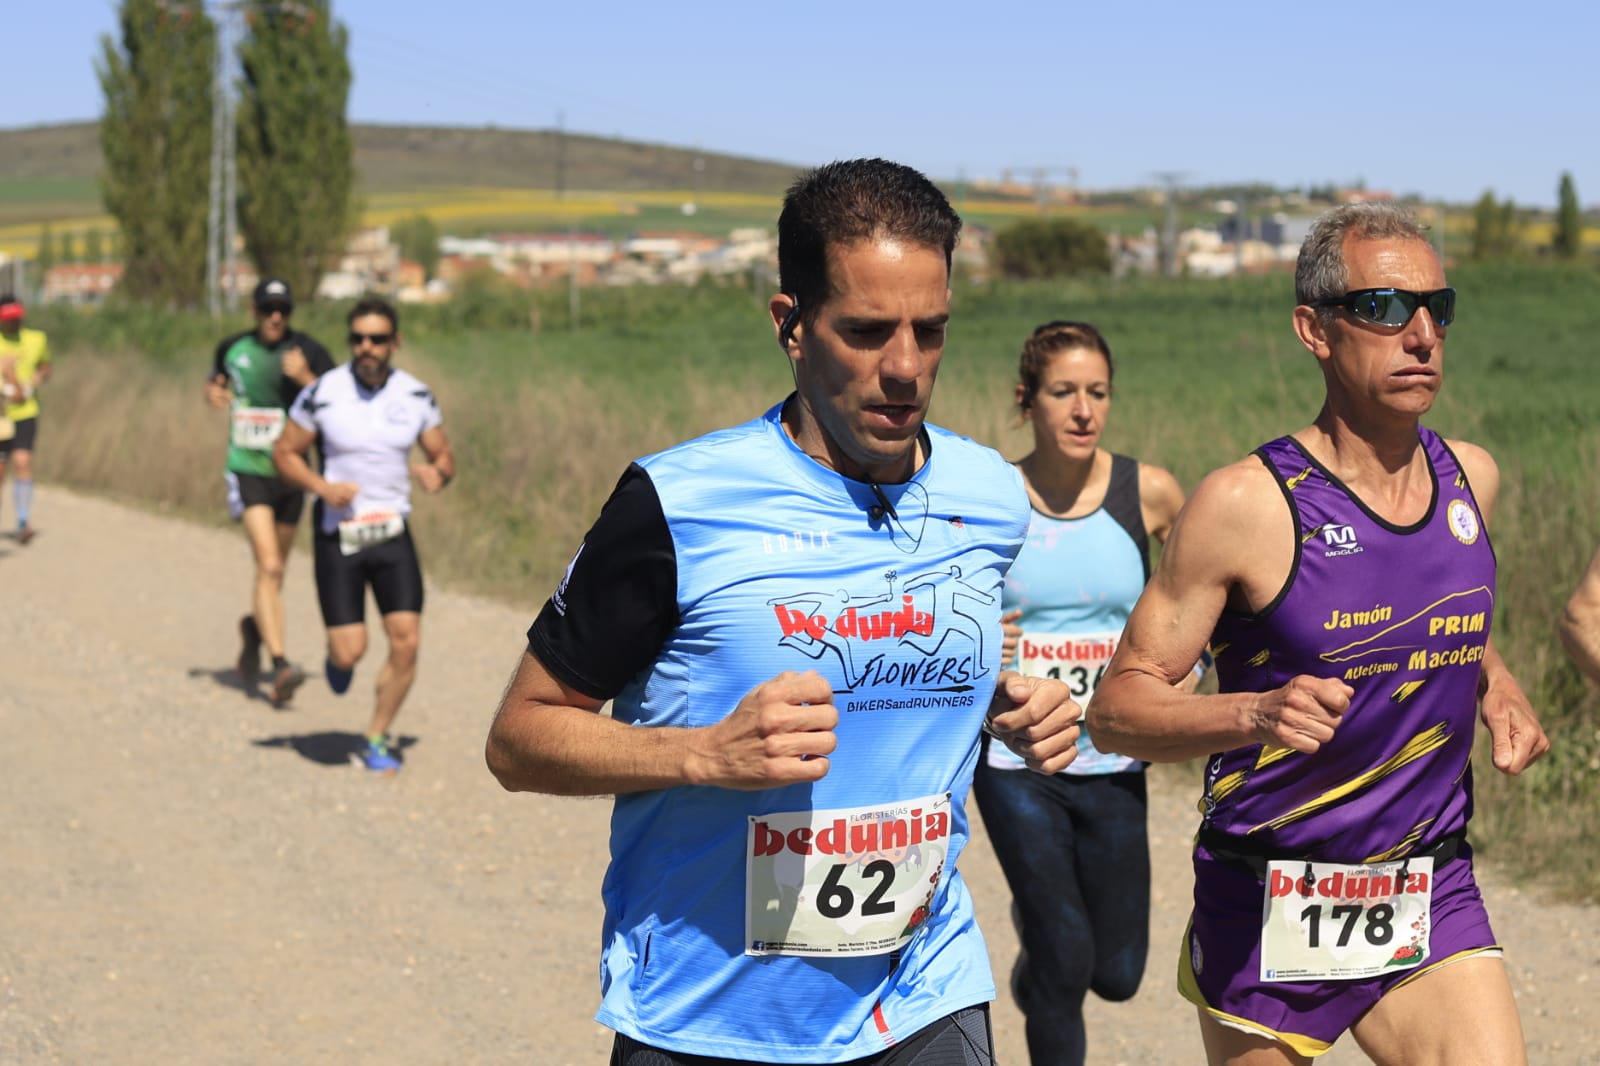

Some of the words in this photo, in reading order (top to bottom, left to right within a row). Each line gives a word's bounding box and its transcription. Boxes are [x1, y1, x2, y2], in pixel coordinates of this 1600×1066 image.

[1324, 604, 1391, 630] Jamón
[1429, 612, 1485, 637] PRIM
[1023, 639, 1119, 661] beduni
[1344, 662, 1399, 680] Atletismo
[1408, 645, 1484, 671] Macotera
[858, 654, 972, 689] FLOWERS
[847, 696, 974, 712] BIKERSandRUNNERS
[850, 808, 910, 823] FLORISTERÍAS
[753, 809, 948, 857] bedunia
[816, 860, 896, 919] 62
[1301, 903, 1395, 948] 178
